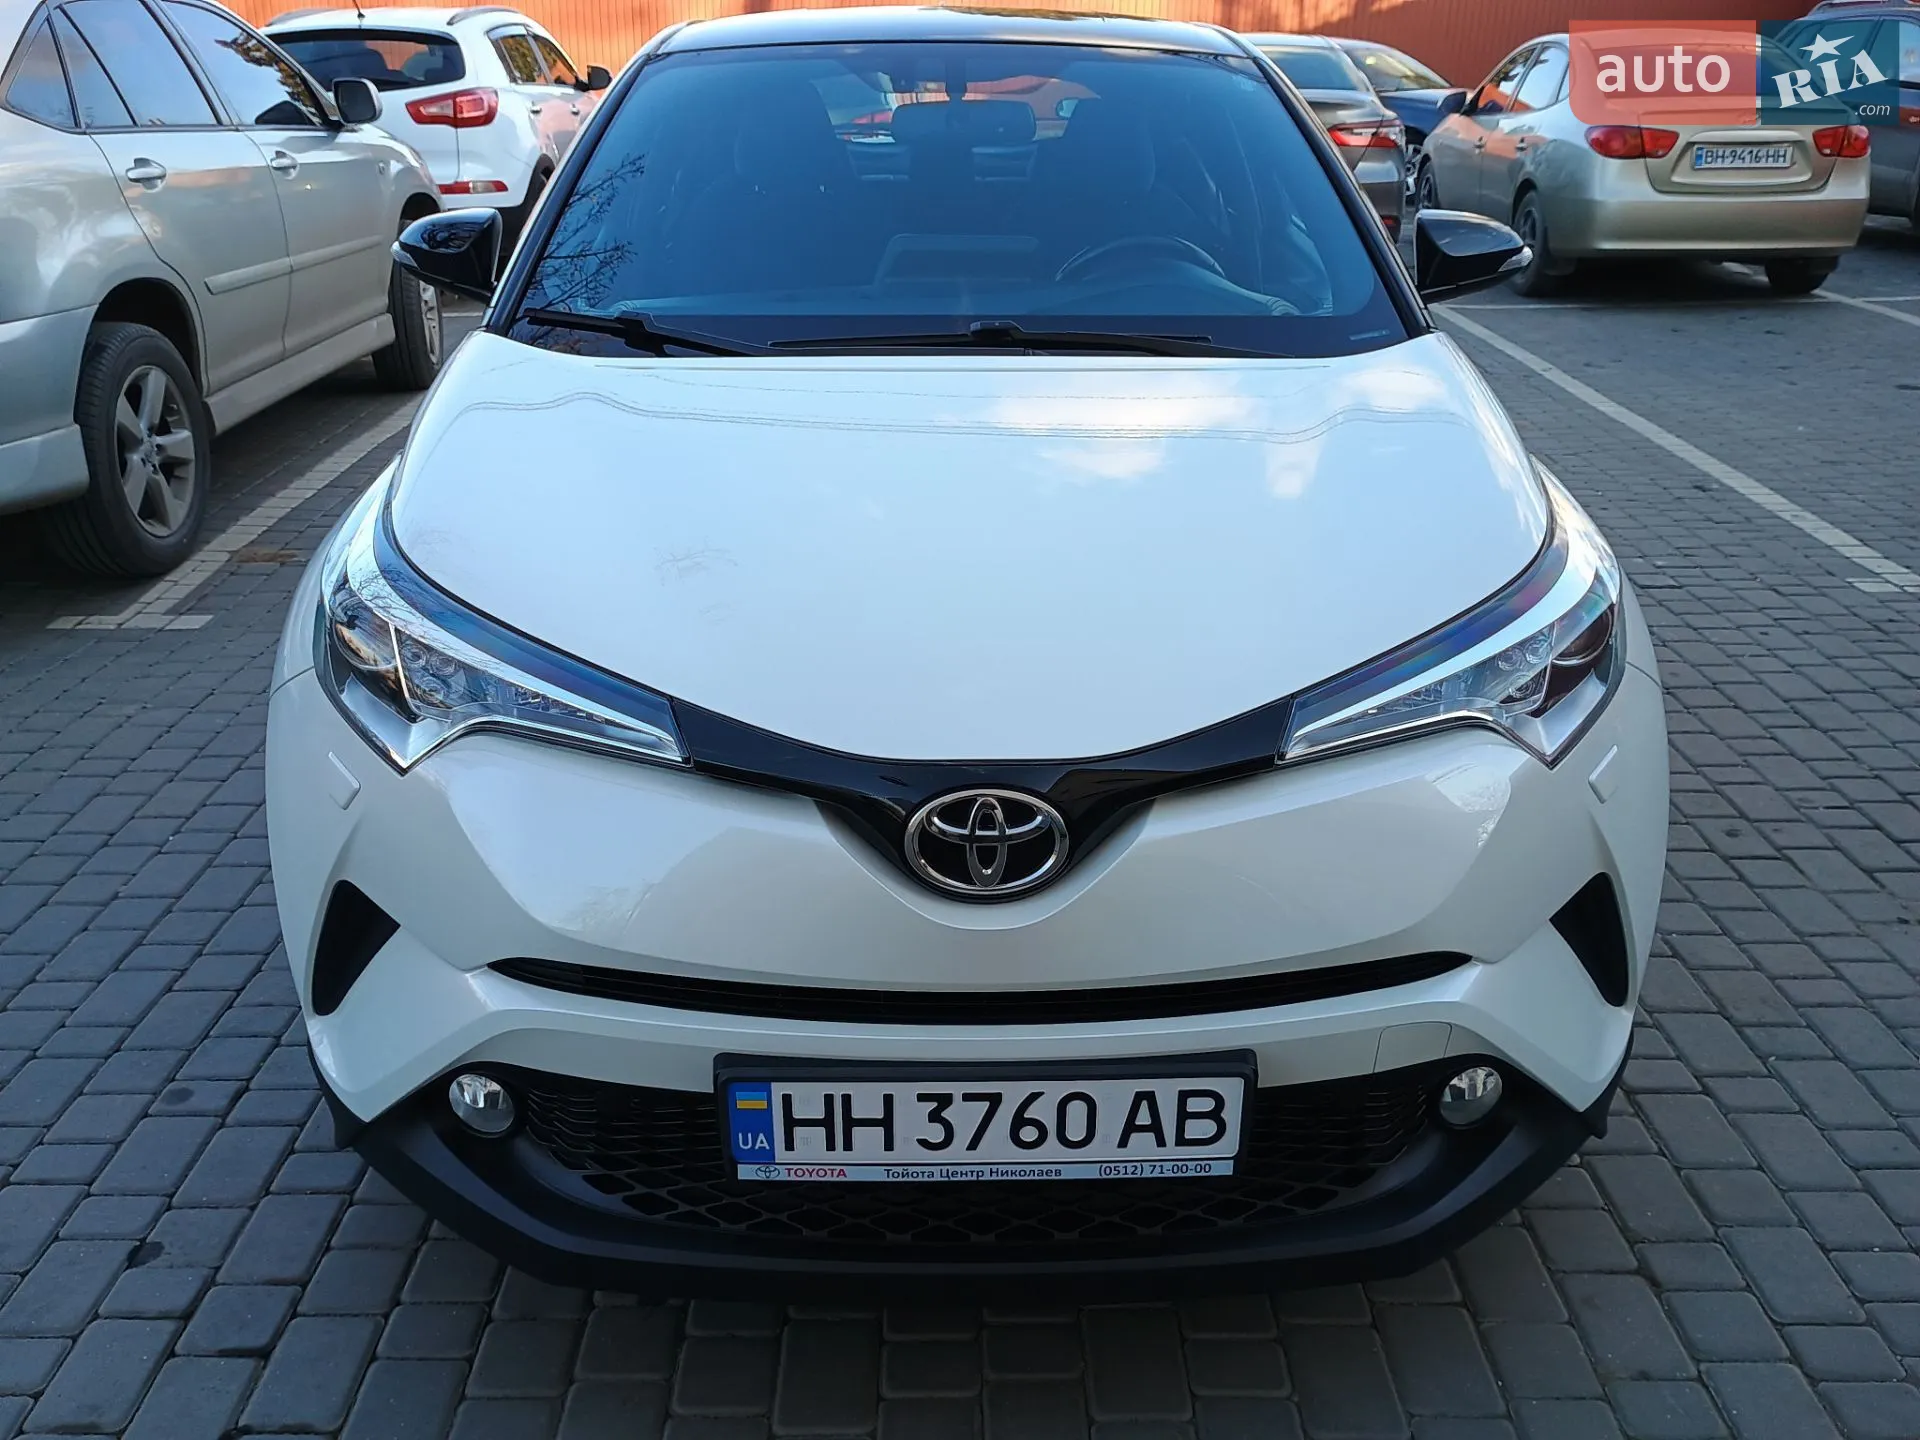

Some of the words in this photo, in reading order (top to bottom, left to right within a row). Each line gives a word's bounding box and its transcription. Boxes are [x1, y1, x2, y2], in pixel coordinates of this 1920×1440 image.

[782, 1093, 894, 1152] HH
[916, 1091, 1097, 1151] 3760
[1116, 1089, 1226, 1148] AB
[738, 1132, 770, 1150] UA
[784, 1167, 848, 1179] TOYOTA
[883, 1167, 935, 1179] Тойота
[939, 1168, 984, 1181] Центр
[989, 1166, 1062, 1179] Николаев
[1098, 1163, 1145, 1177] (0512)
[1149, 1163, 1211, 1175] 71-00-00
